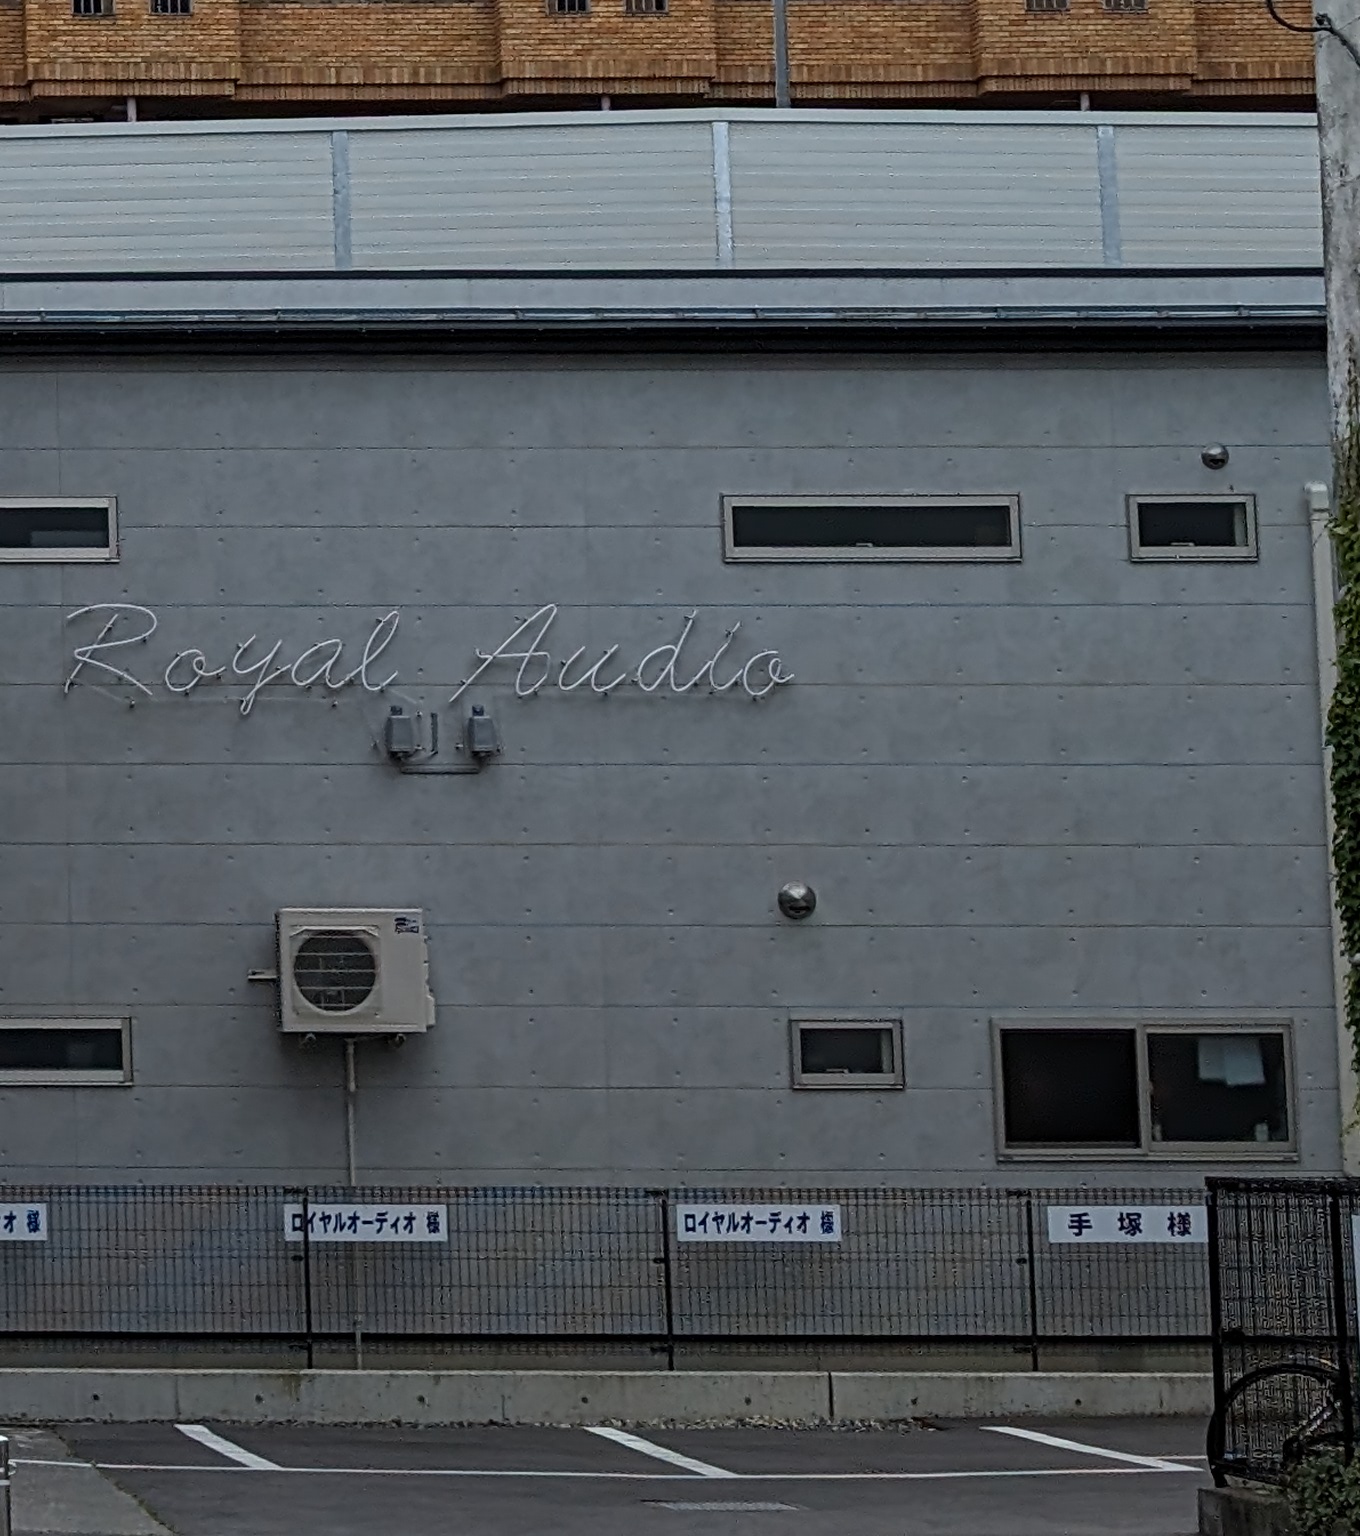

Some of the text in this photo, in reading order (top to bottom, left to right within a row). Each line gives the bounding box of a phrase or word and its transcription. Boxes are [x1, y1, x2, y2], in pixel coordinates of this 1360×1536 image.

[65, 603, 795, 716] Royal Audio
[291, 1211, 416, 1235] ロイヤルオーディオ
[684, 1211, 811, 1234] ロイヤルオーディオ
